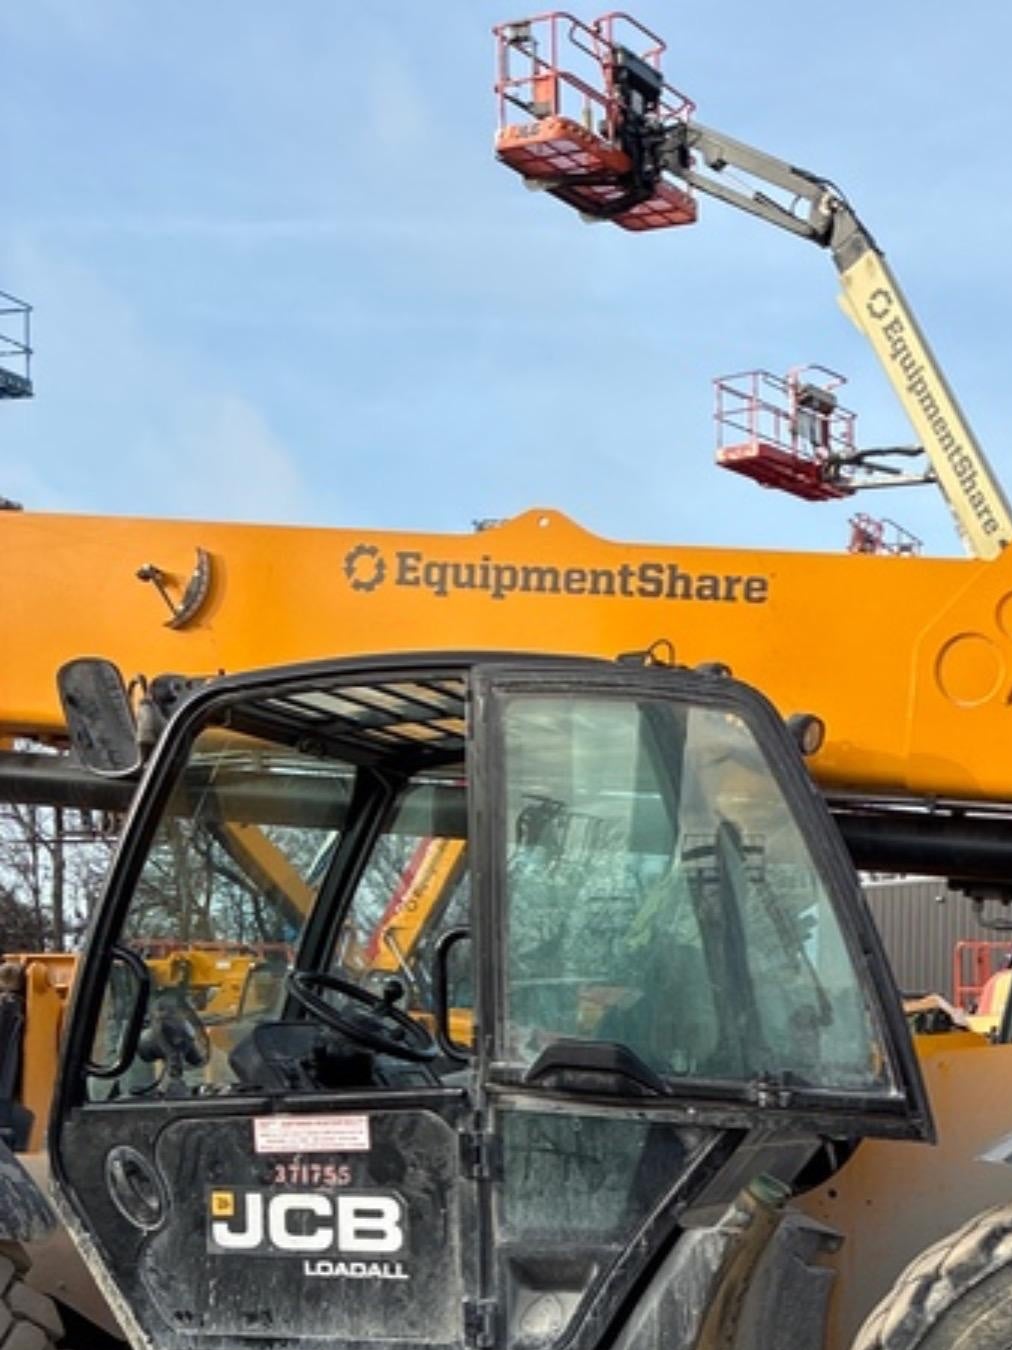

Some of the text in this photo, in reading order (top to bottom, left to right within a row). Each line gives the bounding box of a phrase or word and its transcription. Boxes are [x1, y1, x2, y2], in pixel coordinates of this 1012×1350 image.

[882, 316, 1000, 536] EquipmentShare
[394, 551, 769, 604] EquipmentShare
[273, 1163, 352, 1185] 371755
[212, 1193, 403, 1252] JCB
[304, 1260, 409, 1280] LOADALL
